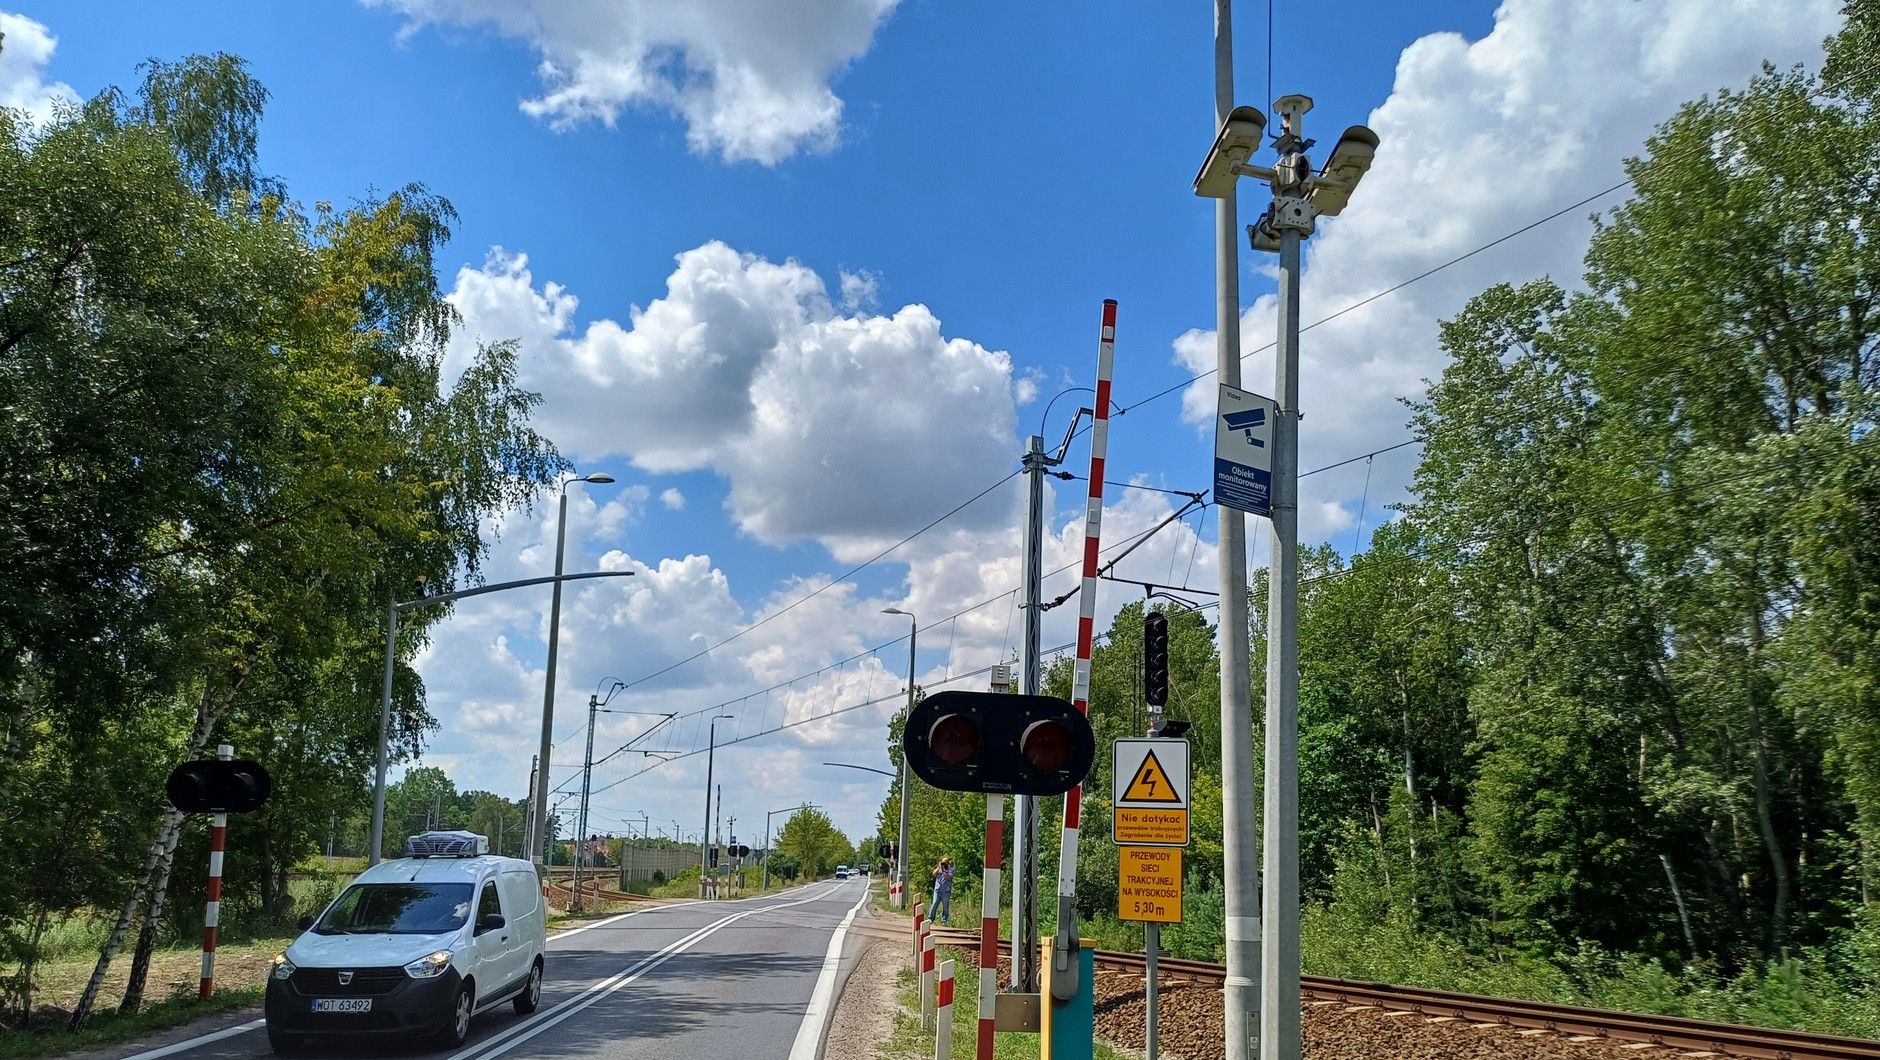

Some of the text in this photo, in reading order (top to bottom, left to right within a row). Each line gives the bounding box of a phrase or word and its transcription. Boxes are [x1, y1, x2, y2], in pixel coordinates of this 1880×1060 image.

[1226, 391, 1241, 401] Video
[1231, 466, 1255, 480] Obiekt
[1218, 472, 1267, 493] monitorowany
[1121, 813, 1181, 825] Nie dotykać
[1120, 831, 1153, 839] Zagrożenie
[1130, 851, 1171, 861] PRZEWODY
[1141, 863, 1160, 873] SIECI
[1127, 875, 1174, 886] TRAKCYJNEJ
[1122, 887, 1179, 898] NA WYSOKOŚCI
[1134, 901, 1165, 916] 5,30 m
[317, 1000, 370, 1011] WOT 63492
